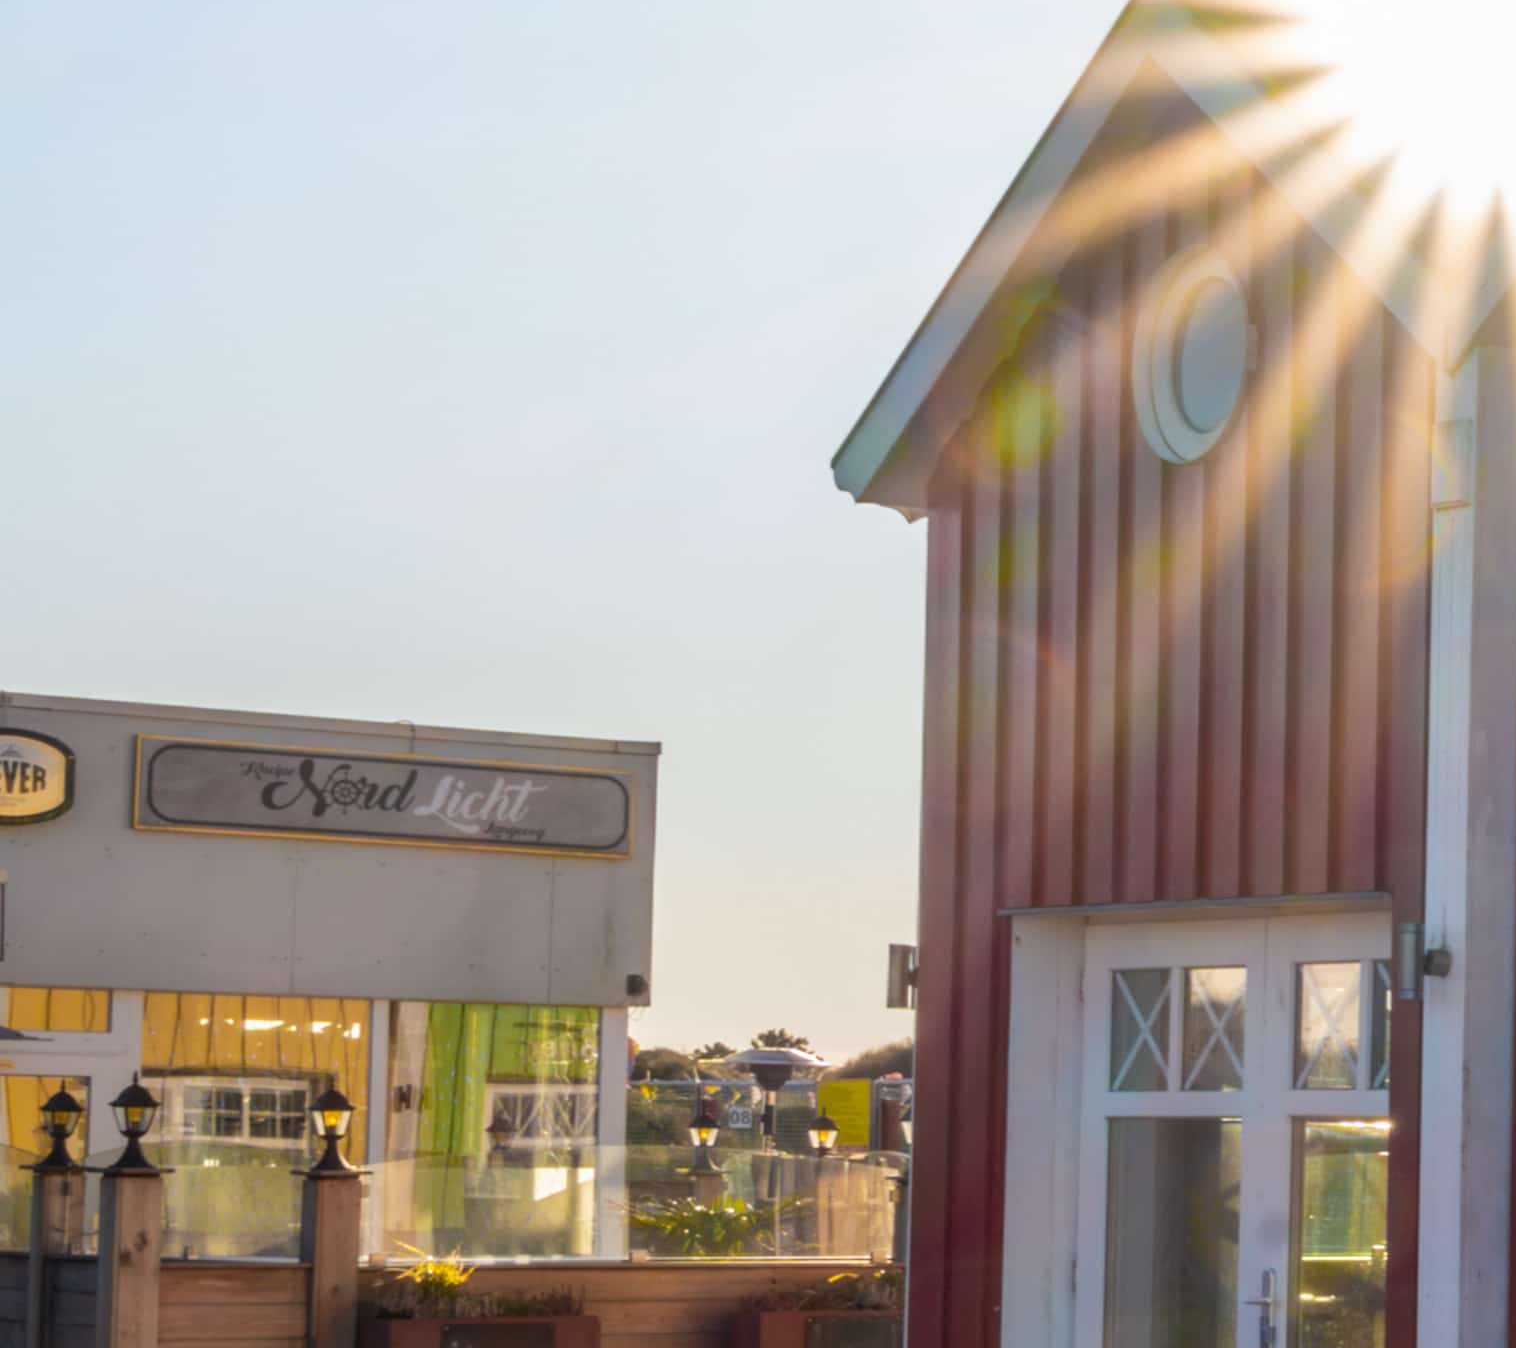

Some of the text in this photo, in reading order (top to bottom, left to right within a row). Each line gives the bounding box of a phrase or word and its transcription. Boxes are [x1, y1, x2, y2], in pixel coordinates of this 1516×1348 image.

[0, 759, 46, 794] VER
[261, 758, 547, 833] Nord Licht
